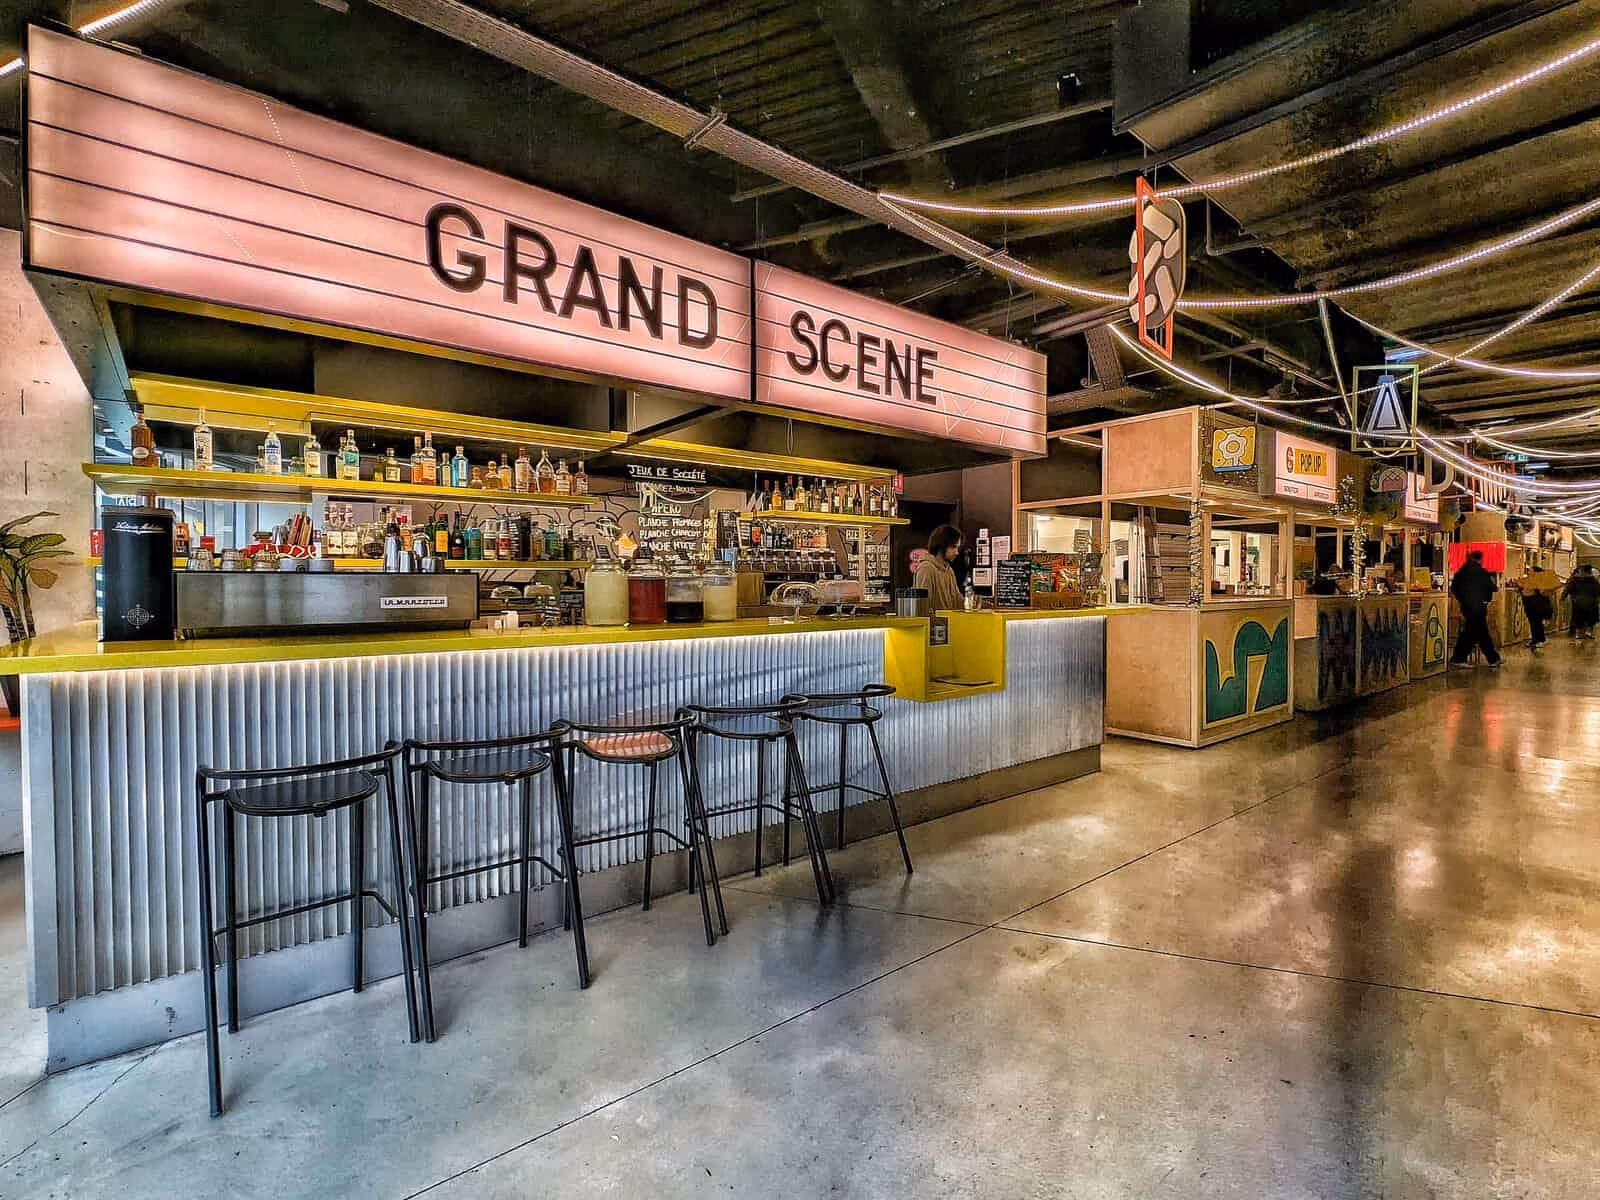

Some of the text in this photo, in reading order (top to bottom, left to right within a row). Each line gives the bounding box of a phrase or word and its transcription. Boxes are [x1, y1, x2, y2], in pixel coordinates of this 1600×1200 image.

[425, 202, 718, 350] GRAND
[785, 310, 938, 406] SCENE
[627, 464, 653, 476] JEUX
[656, 467, 669, 477] DE
[1300, 453, 1322, 473] POP UP
